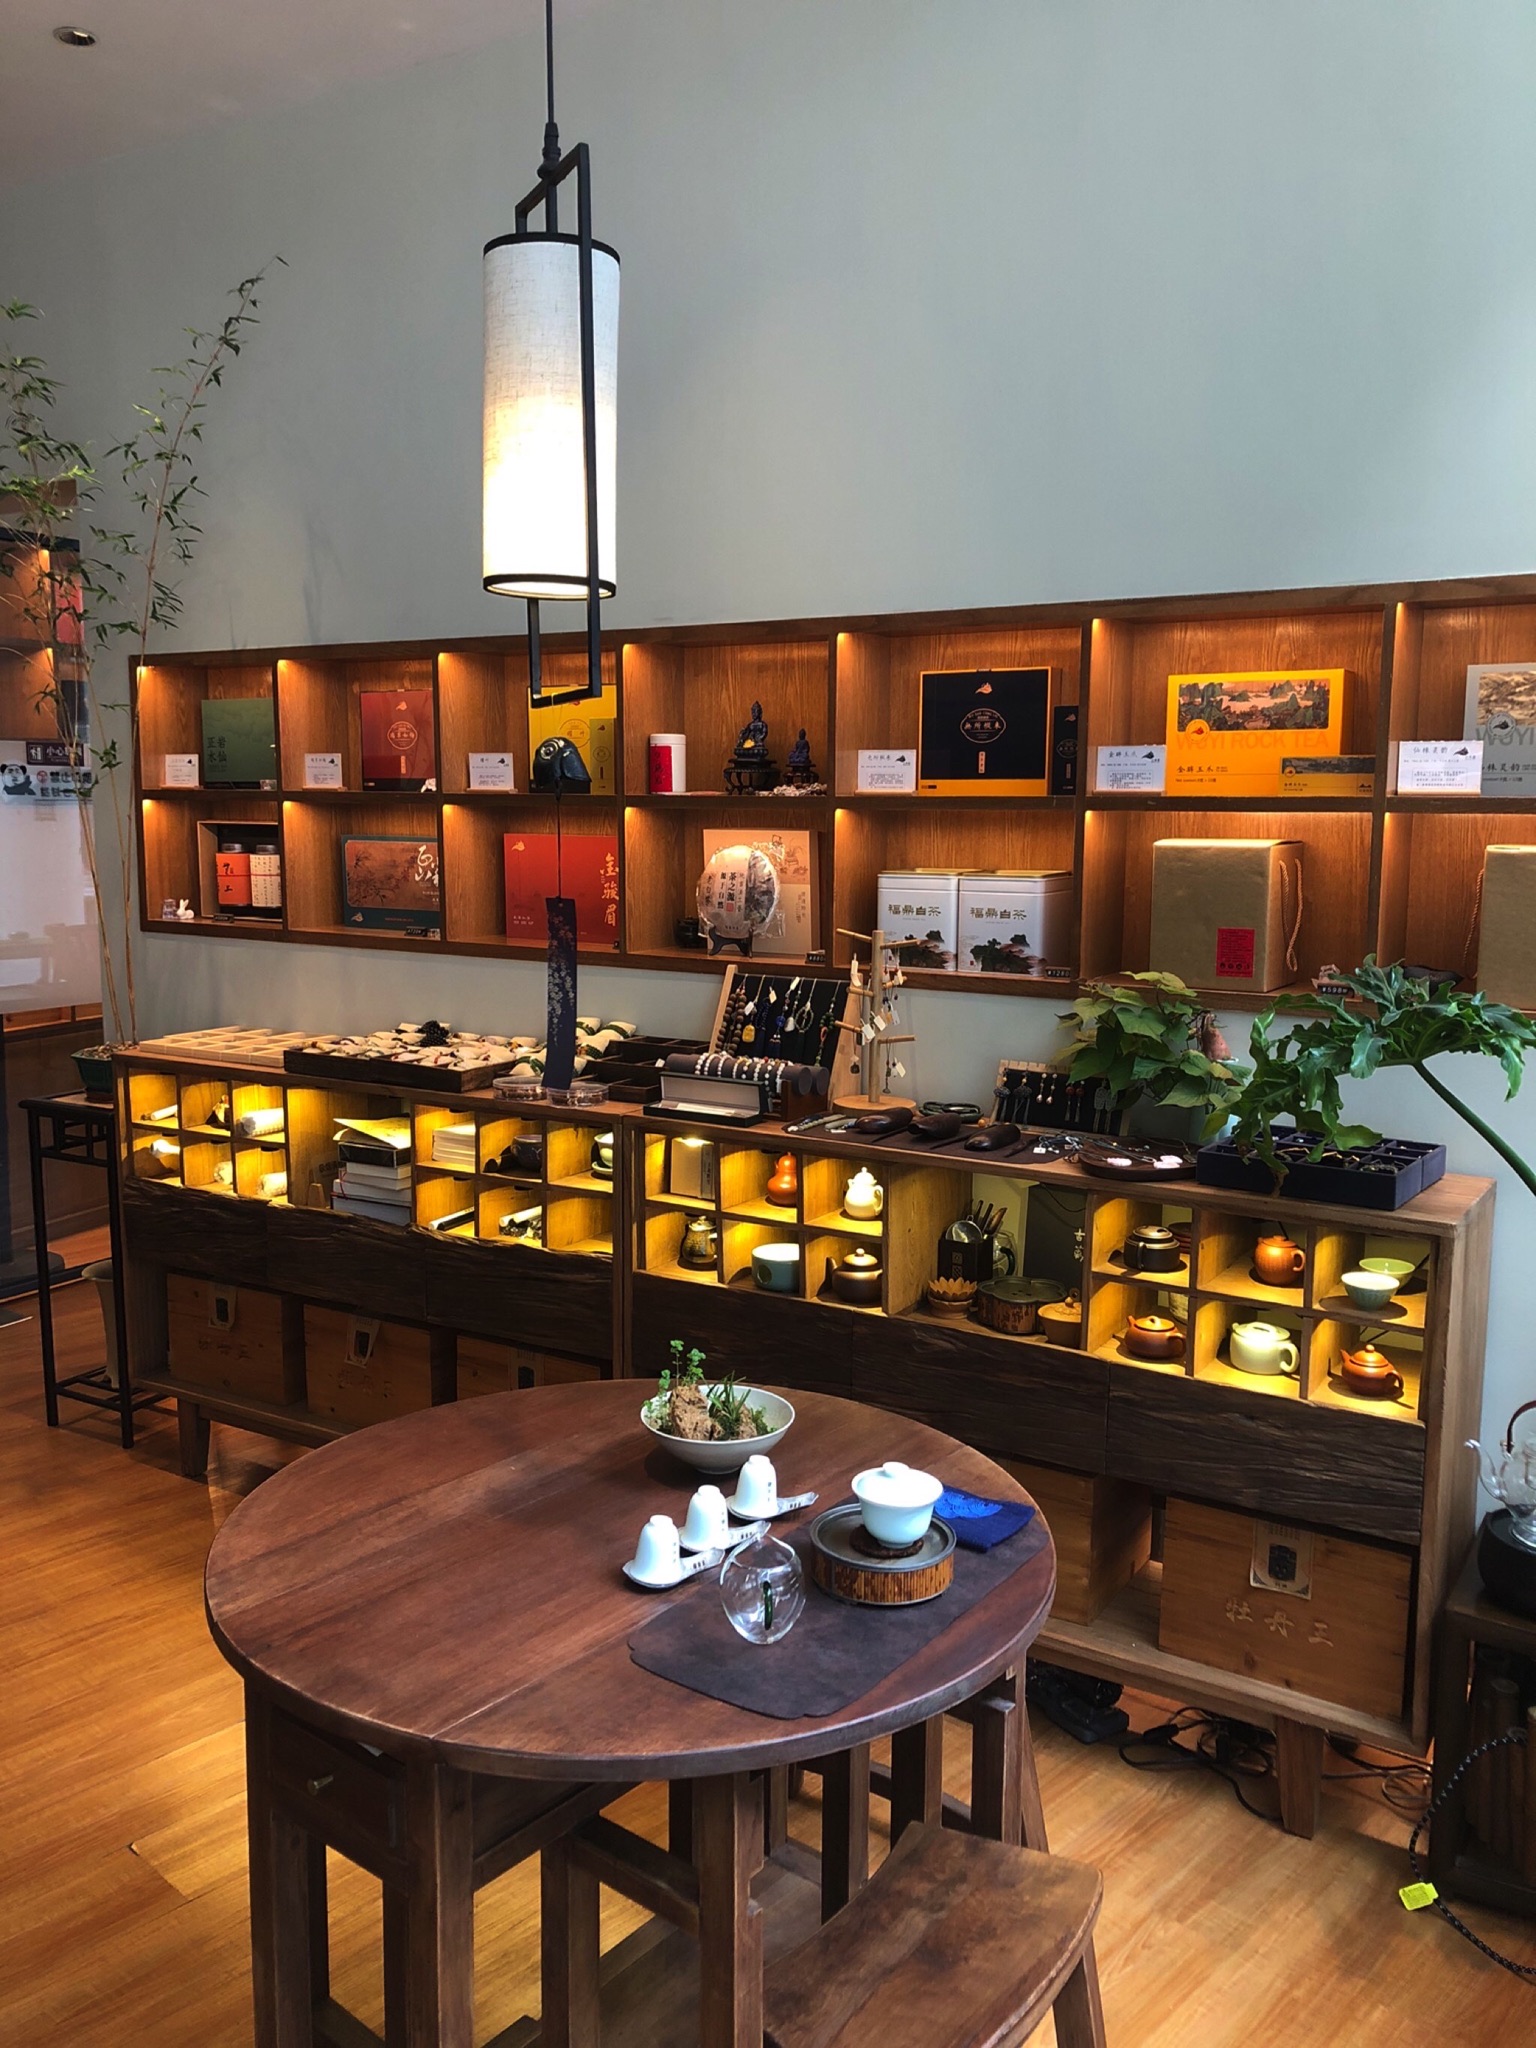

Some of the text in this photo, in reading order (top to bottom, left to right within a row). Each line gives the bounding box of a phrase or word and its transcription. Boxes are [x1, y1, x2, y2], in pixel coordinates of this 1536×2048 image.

[1231, 732, 1284, 749] ROCK
[1293, 731, 1329, 748] TEA
[888, 904, 941, 917] 福鼎白茶
[970, 907, 1027, 921] 福鼎白茶
